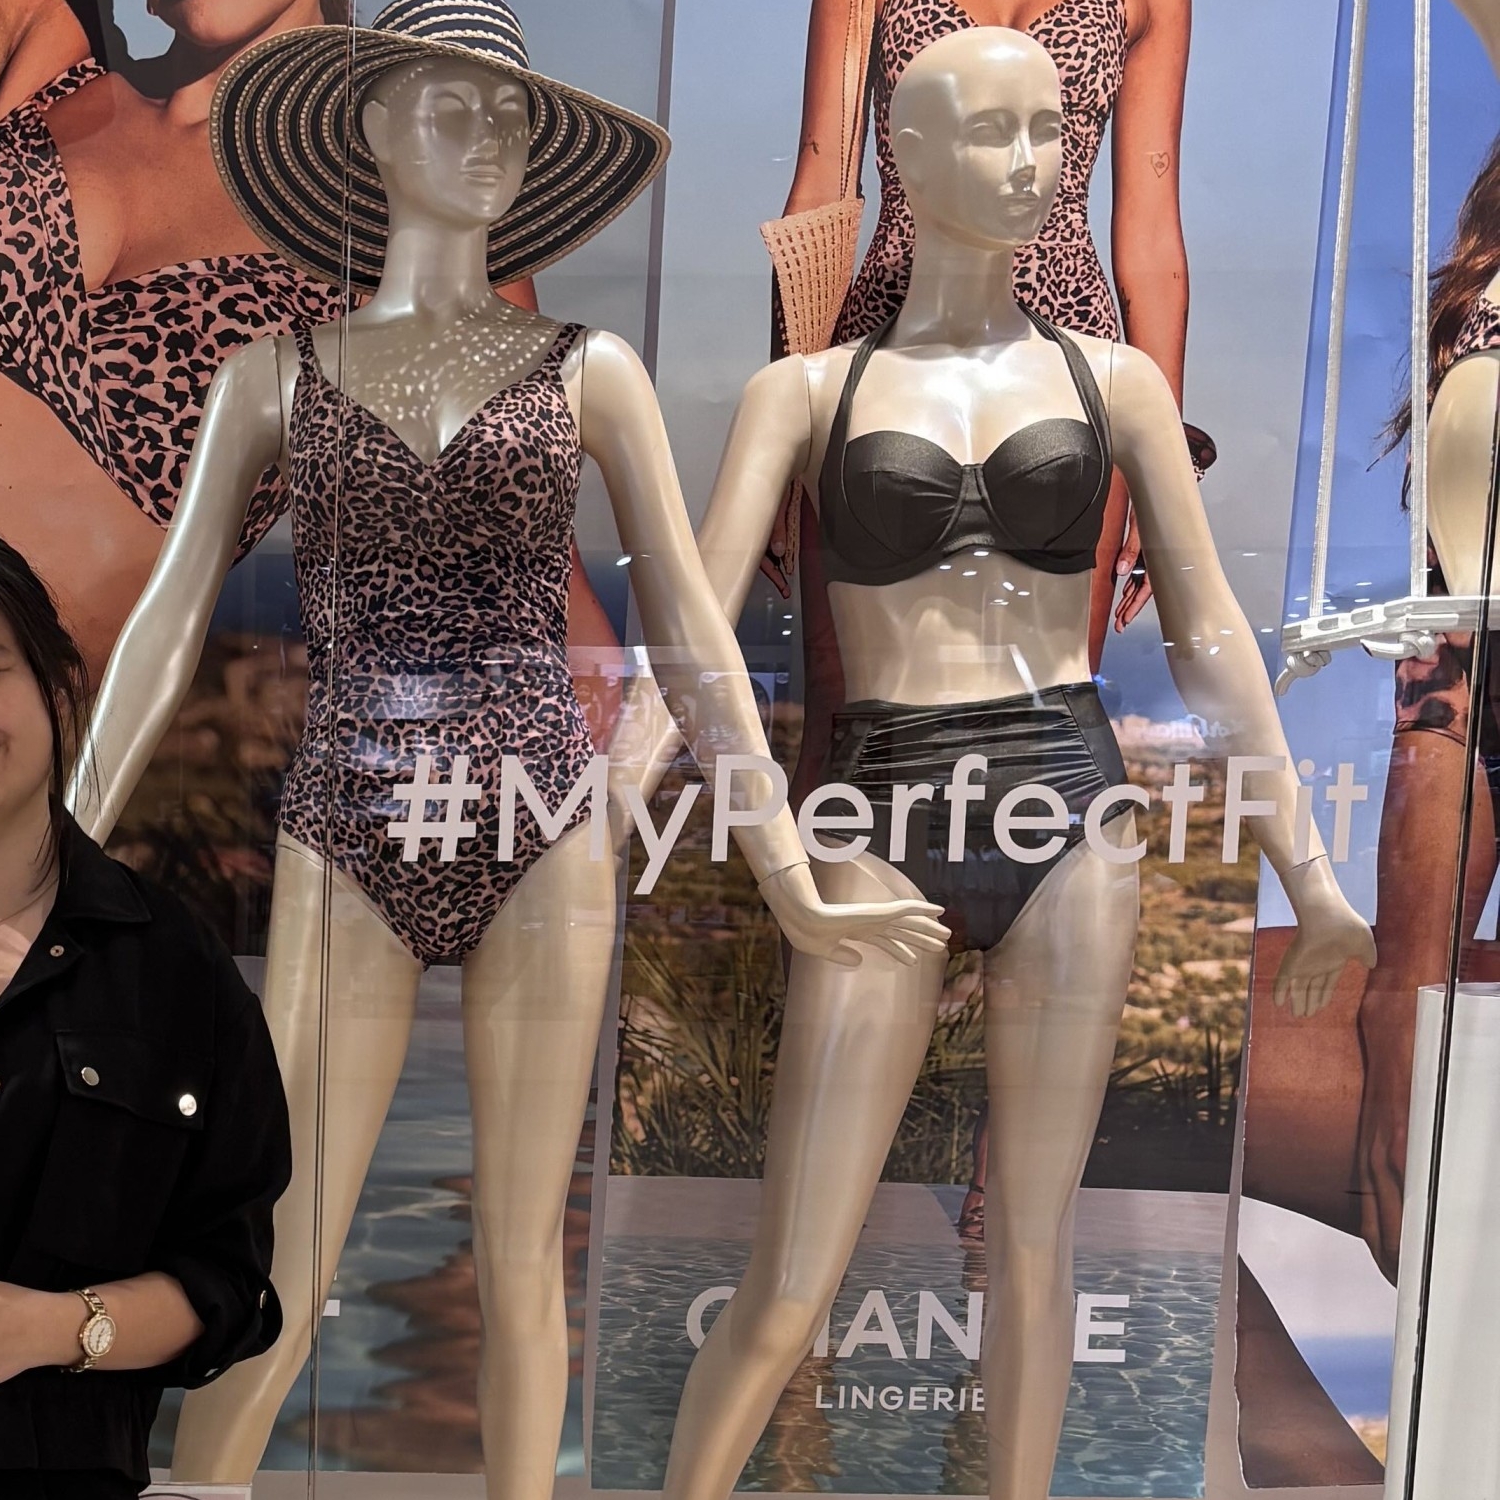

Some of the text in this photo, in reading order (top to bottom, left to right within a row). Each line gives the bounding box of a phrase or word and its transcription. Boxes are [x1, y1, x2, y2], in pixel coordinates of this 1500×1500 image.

[386, 753, 1368, 895] #MyPerfectFit
[686, 1286, 1130, 1363] CANE
[815, 1385, 985, 1412] LINGERIE
